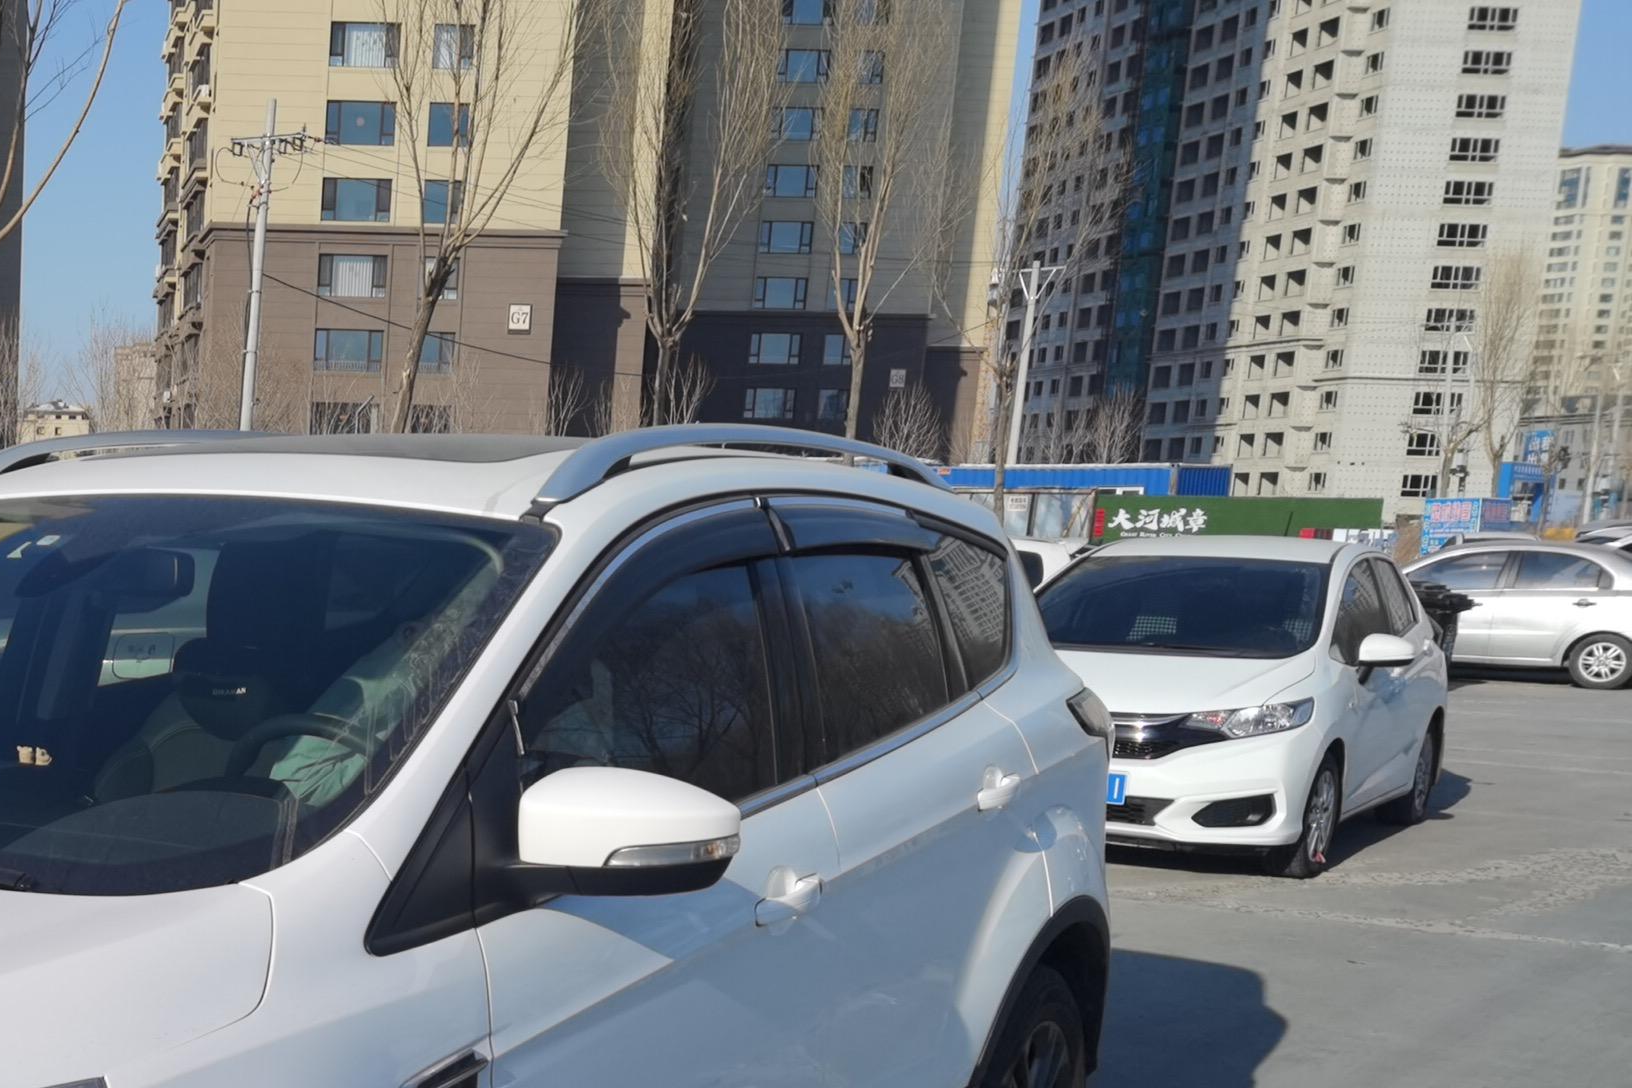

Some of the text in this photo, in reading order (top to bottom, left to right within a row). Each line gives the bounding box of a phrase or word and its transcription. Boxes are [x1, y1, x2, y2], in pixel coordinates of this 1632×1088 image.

[511, 311, 529, 325] G7
[1108, 507, 1208, 533] 大河城章
